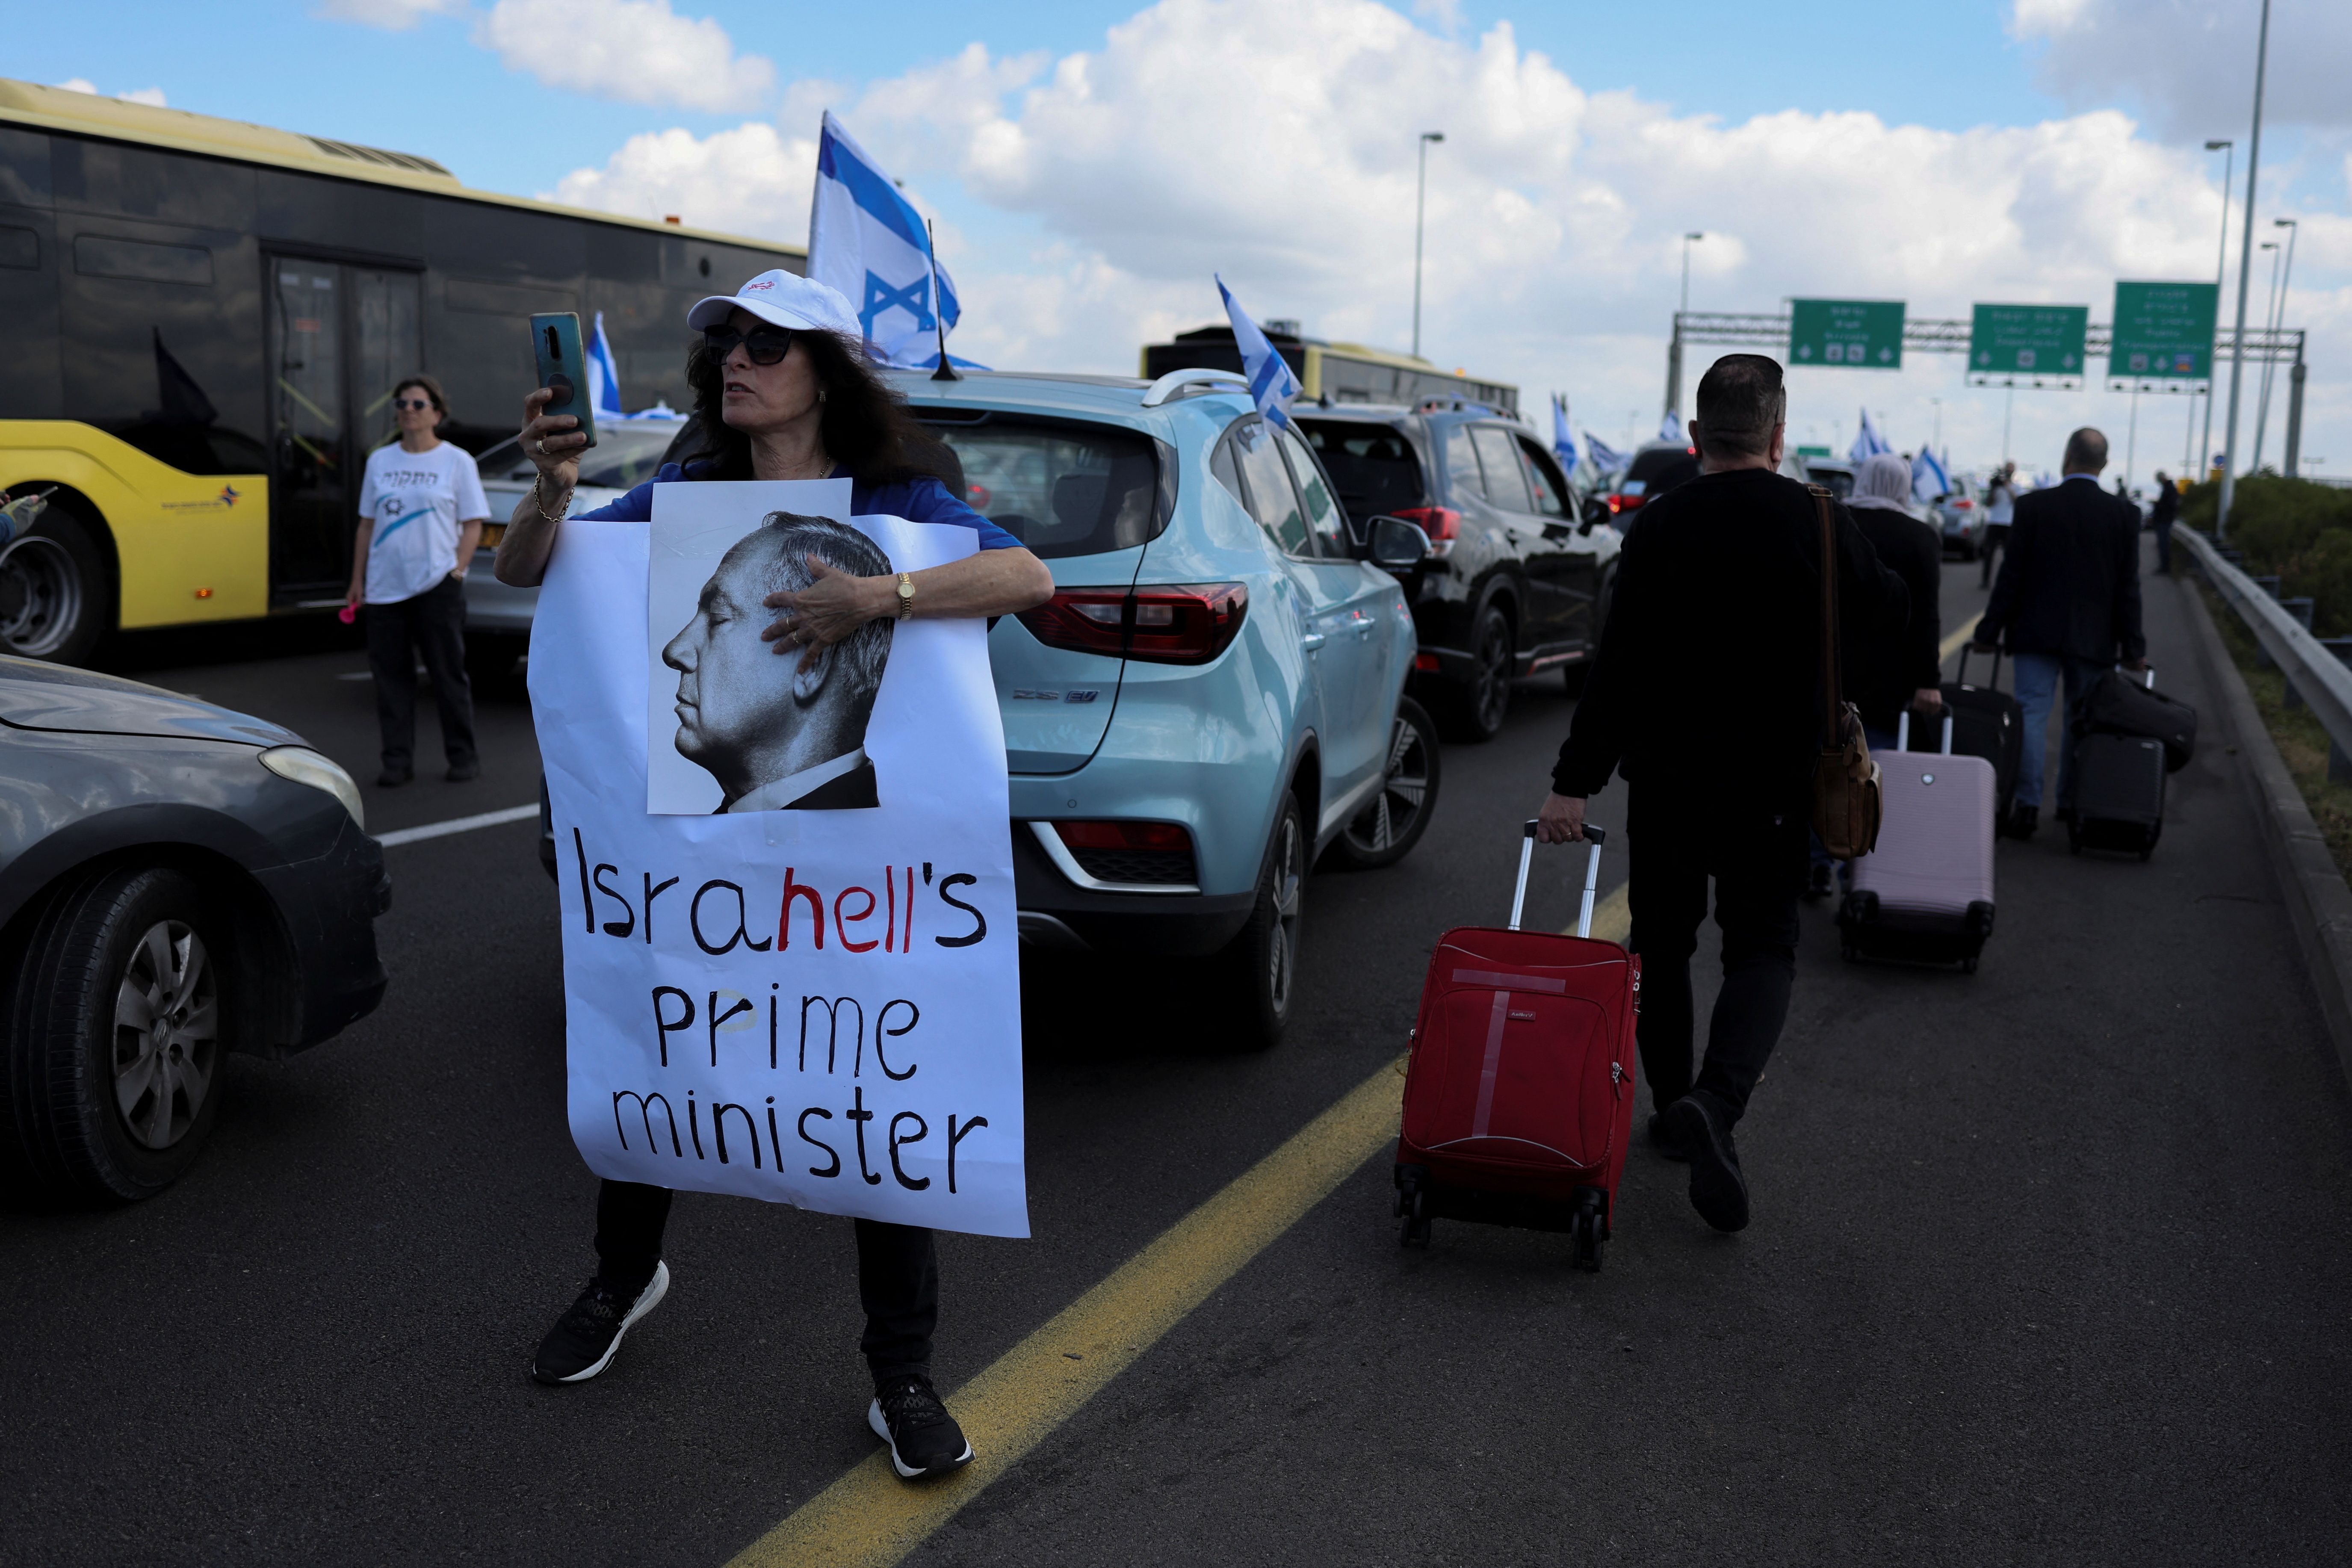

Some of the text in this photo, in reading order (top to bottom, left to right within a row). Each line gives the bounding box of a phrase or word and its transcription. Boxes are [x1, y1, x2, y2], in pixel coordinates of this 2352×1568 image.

[1013, 688, 1098, 702] ZS EV
[573, 827, 987, 956] Israhell's
[612, 1086, 989, 1195] minister
